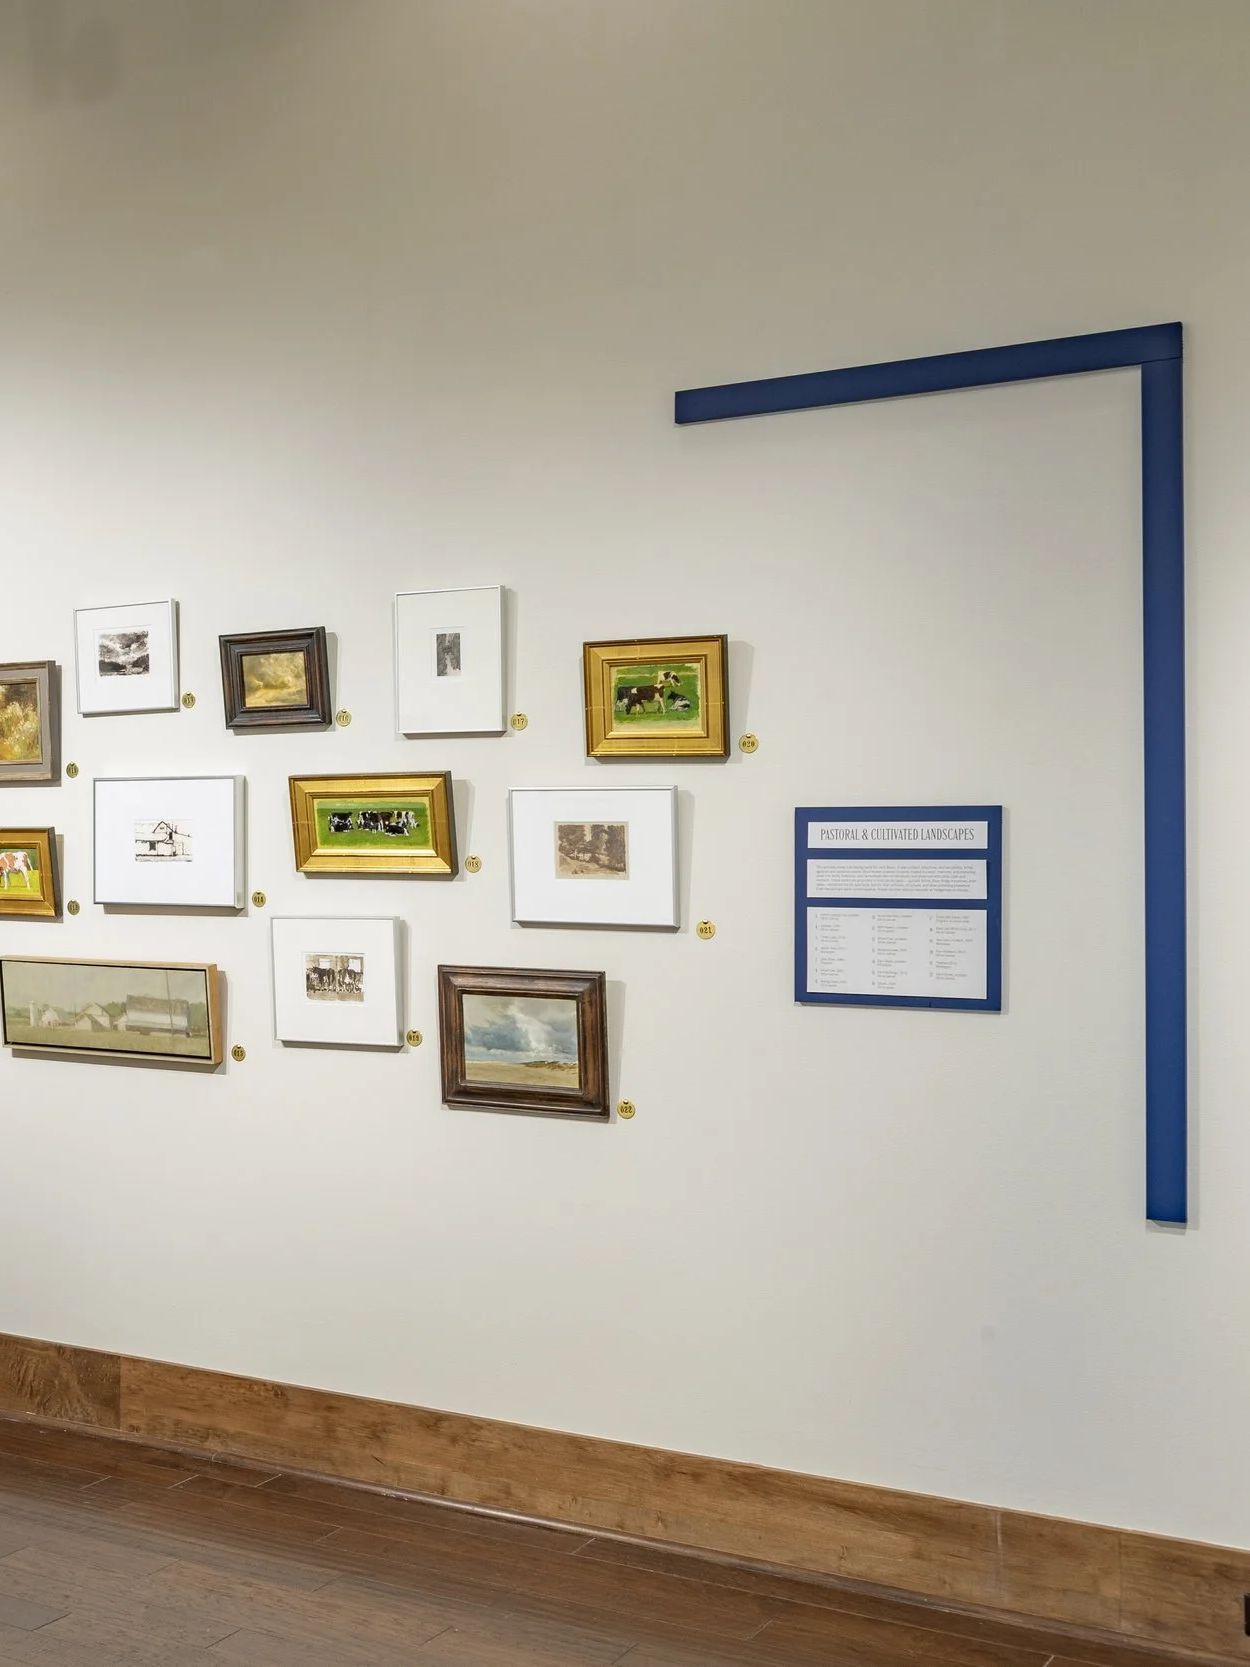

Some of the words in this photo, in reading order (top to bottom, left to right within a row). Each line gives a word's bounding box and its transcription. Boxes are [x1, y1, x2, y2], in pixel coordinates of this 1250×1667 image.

[820, 828, 860, 841] PASTORAL
[861, 828, 869, 841] &
[871, 828, 918, 841] CULTIVATED
[920, 828, 975, 841] LANDSCAPES
[699, 926, 712, 934] 021
